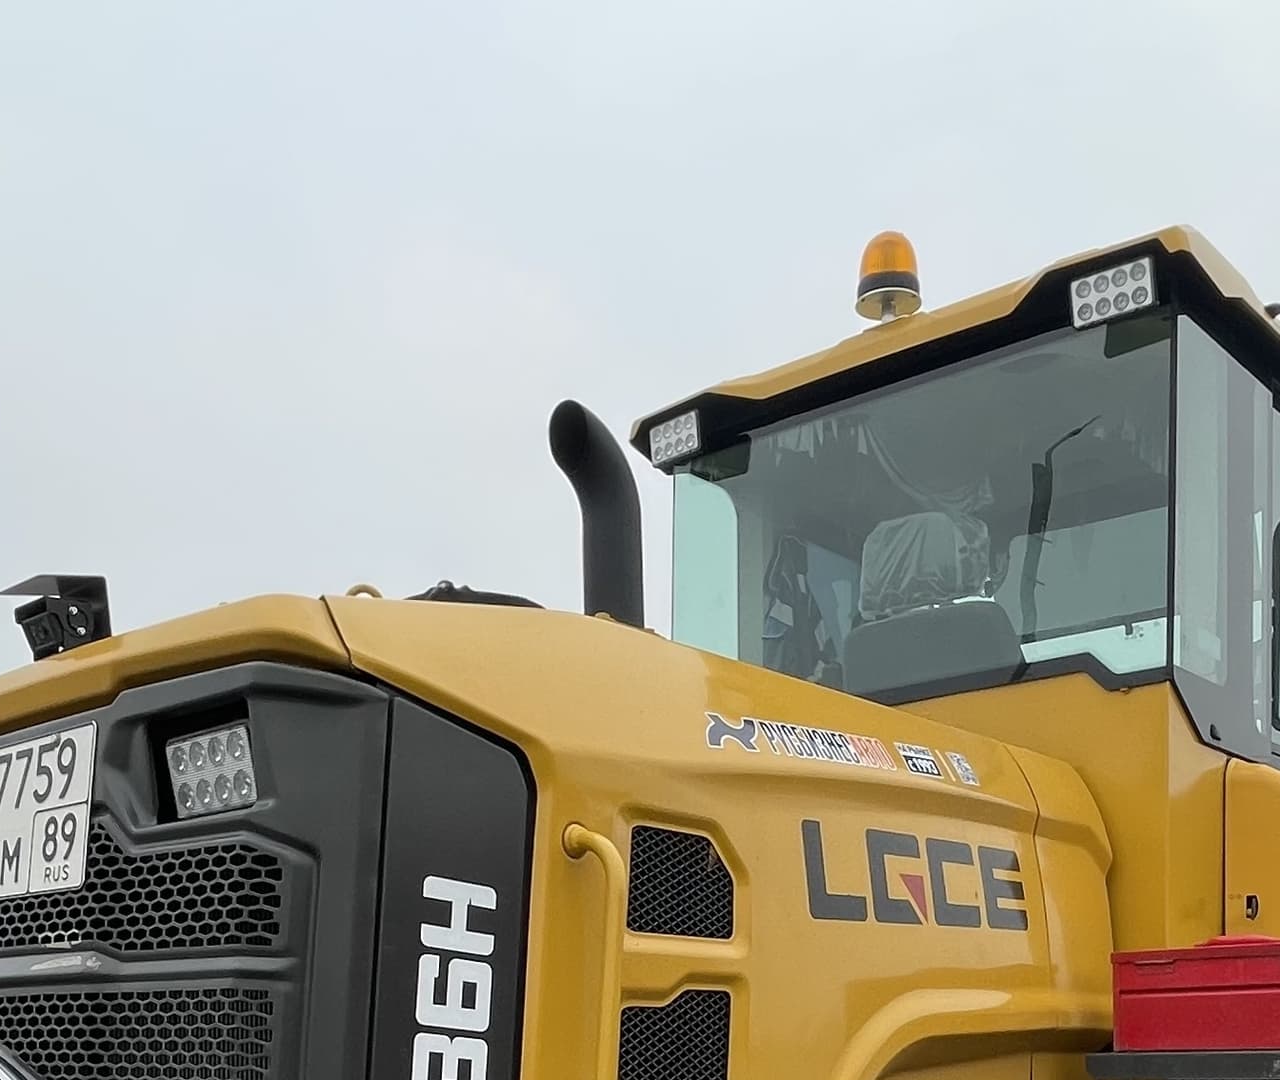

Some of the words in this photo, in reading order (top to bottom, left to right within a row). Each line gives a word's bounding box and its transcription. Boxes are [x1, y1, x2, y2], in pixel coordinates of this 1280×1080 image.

[42, 812, 78, 863] 89
[43, 863, 71, 884] RUS
[801, 818, 1029, 931] LGCE
